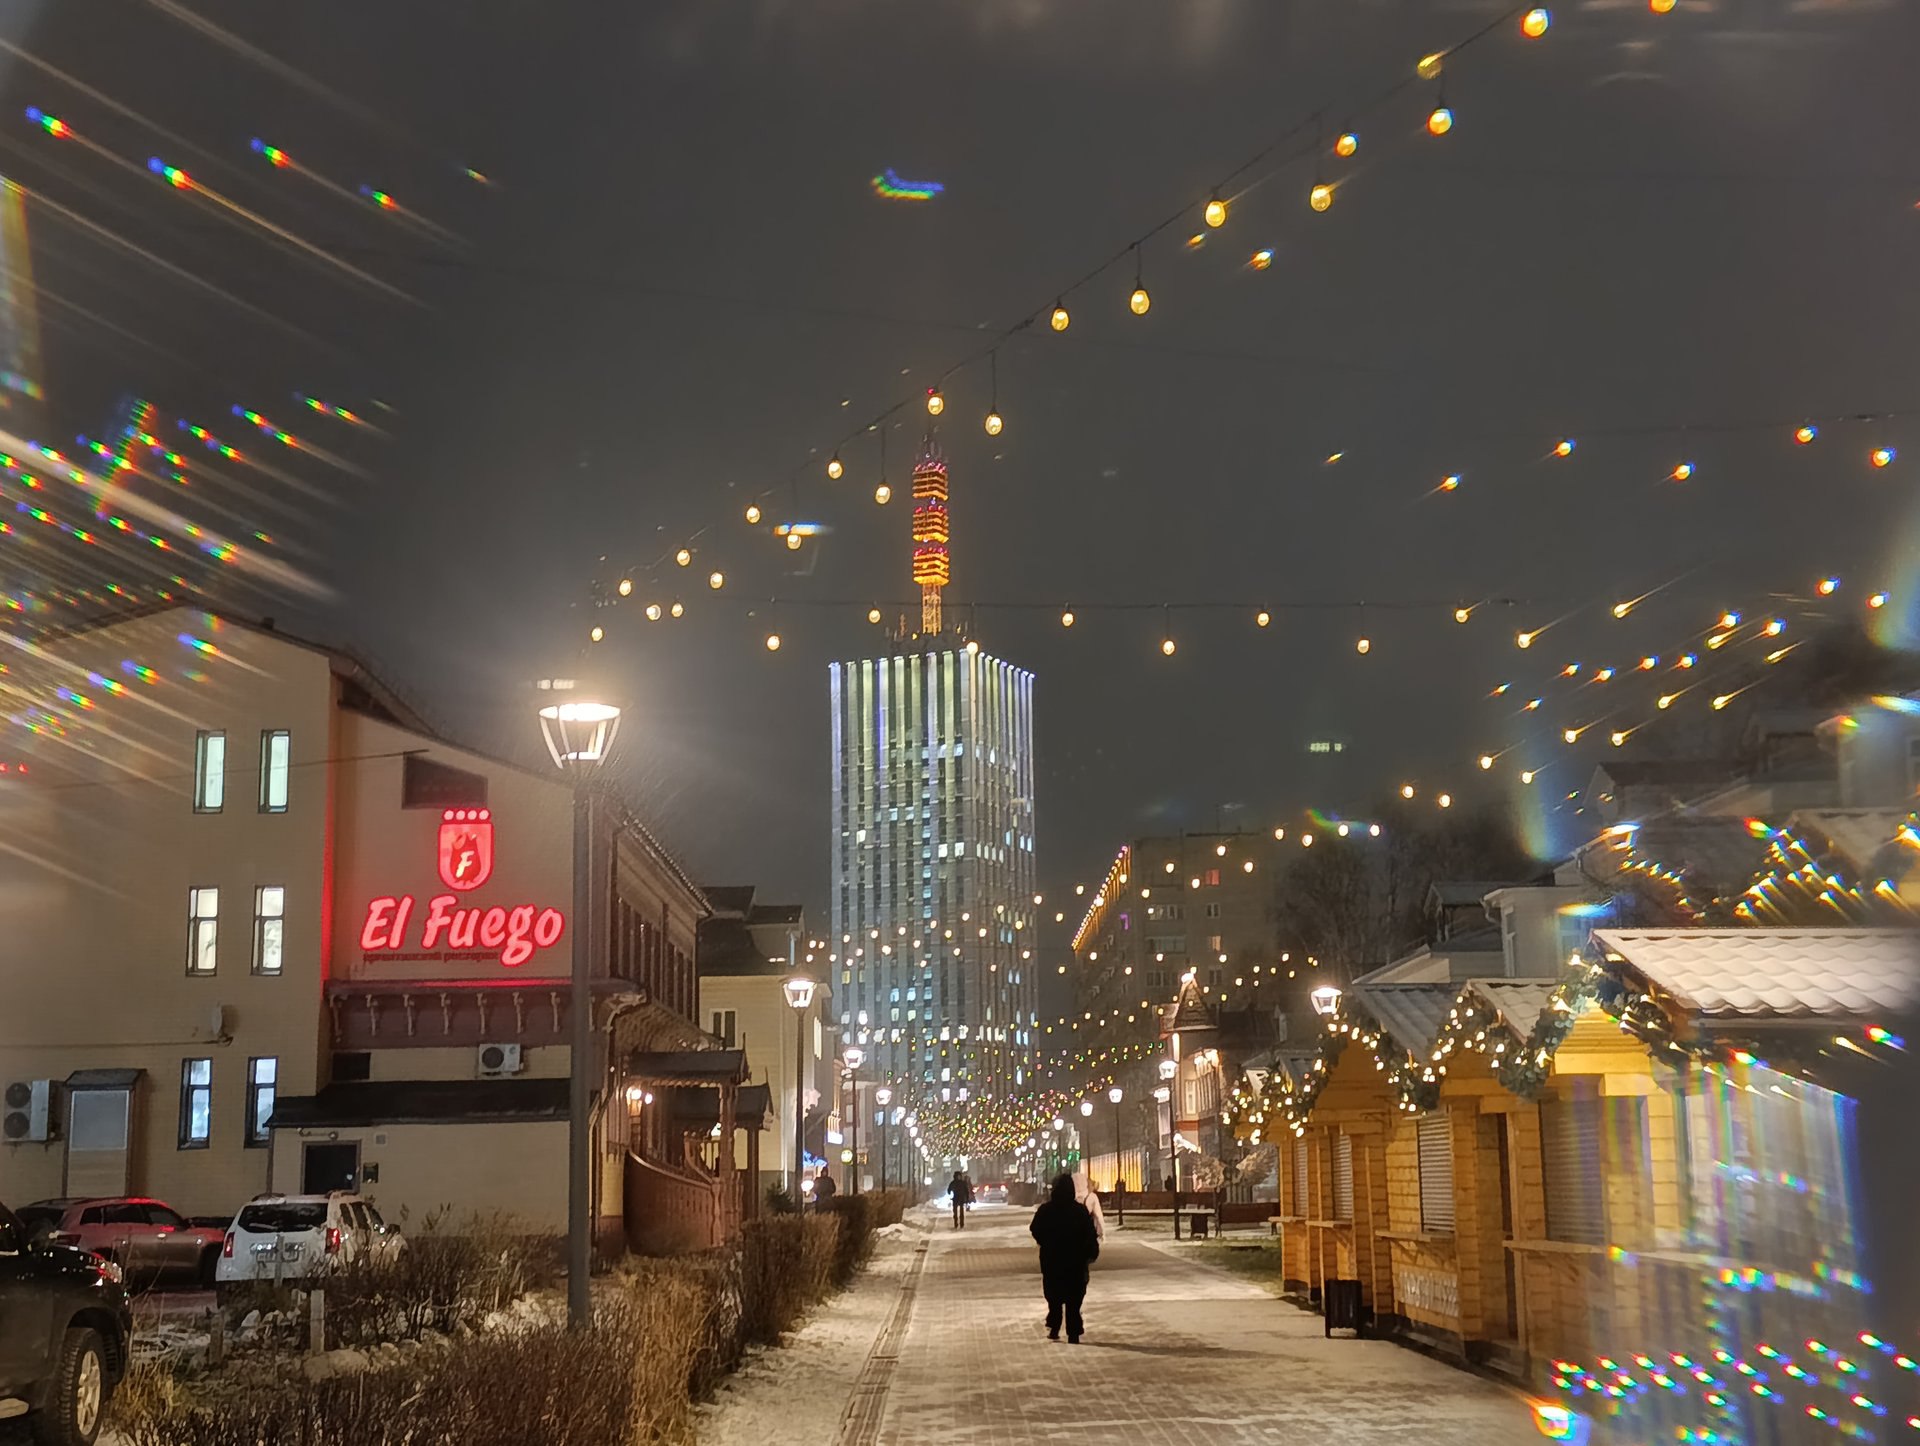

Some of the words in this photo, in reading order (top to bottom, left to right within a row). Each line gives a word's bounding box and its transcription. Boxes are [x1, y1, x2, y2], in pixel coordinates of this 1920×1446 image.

[455, 850, 475, 878] F
[360, 895, 414, 949] El
[421, 895, 565, 967] Fuego
